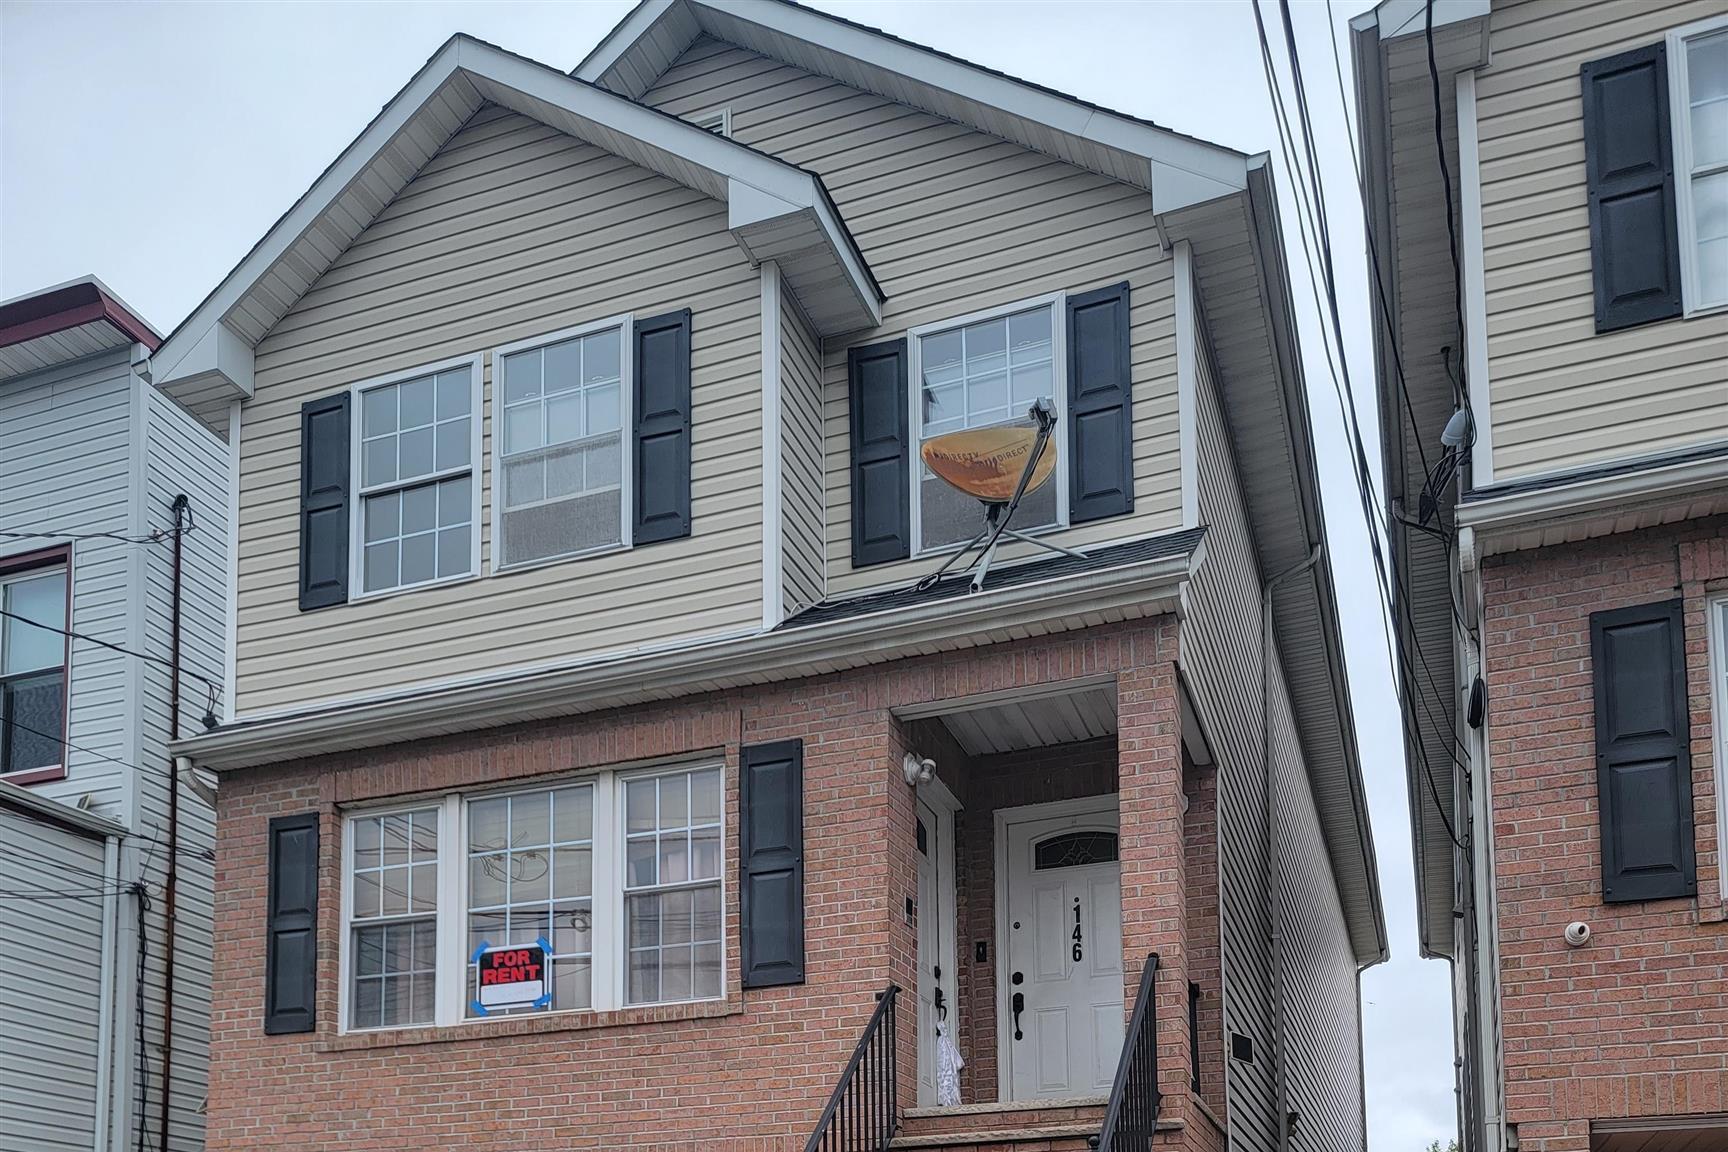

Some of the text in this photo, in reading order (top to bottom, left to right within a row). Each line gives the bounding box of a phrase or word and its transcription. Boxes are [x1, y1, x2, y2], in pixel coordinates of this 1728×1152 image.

[1072, 904, 1082, 962] 146
[492, 950, 530, 968] FOR
[482, 965, 540, 985] RENT
